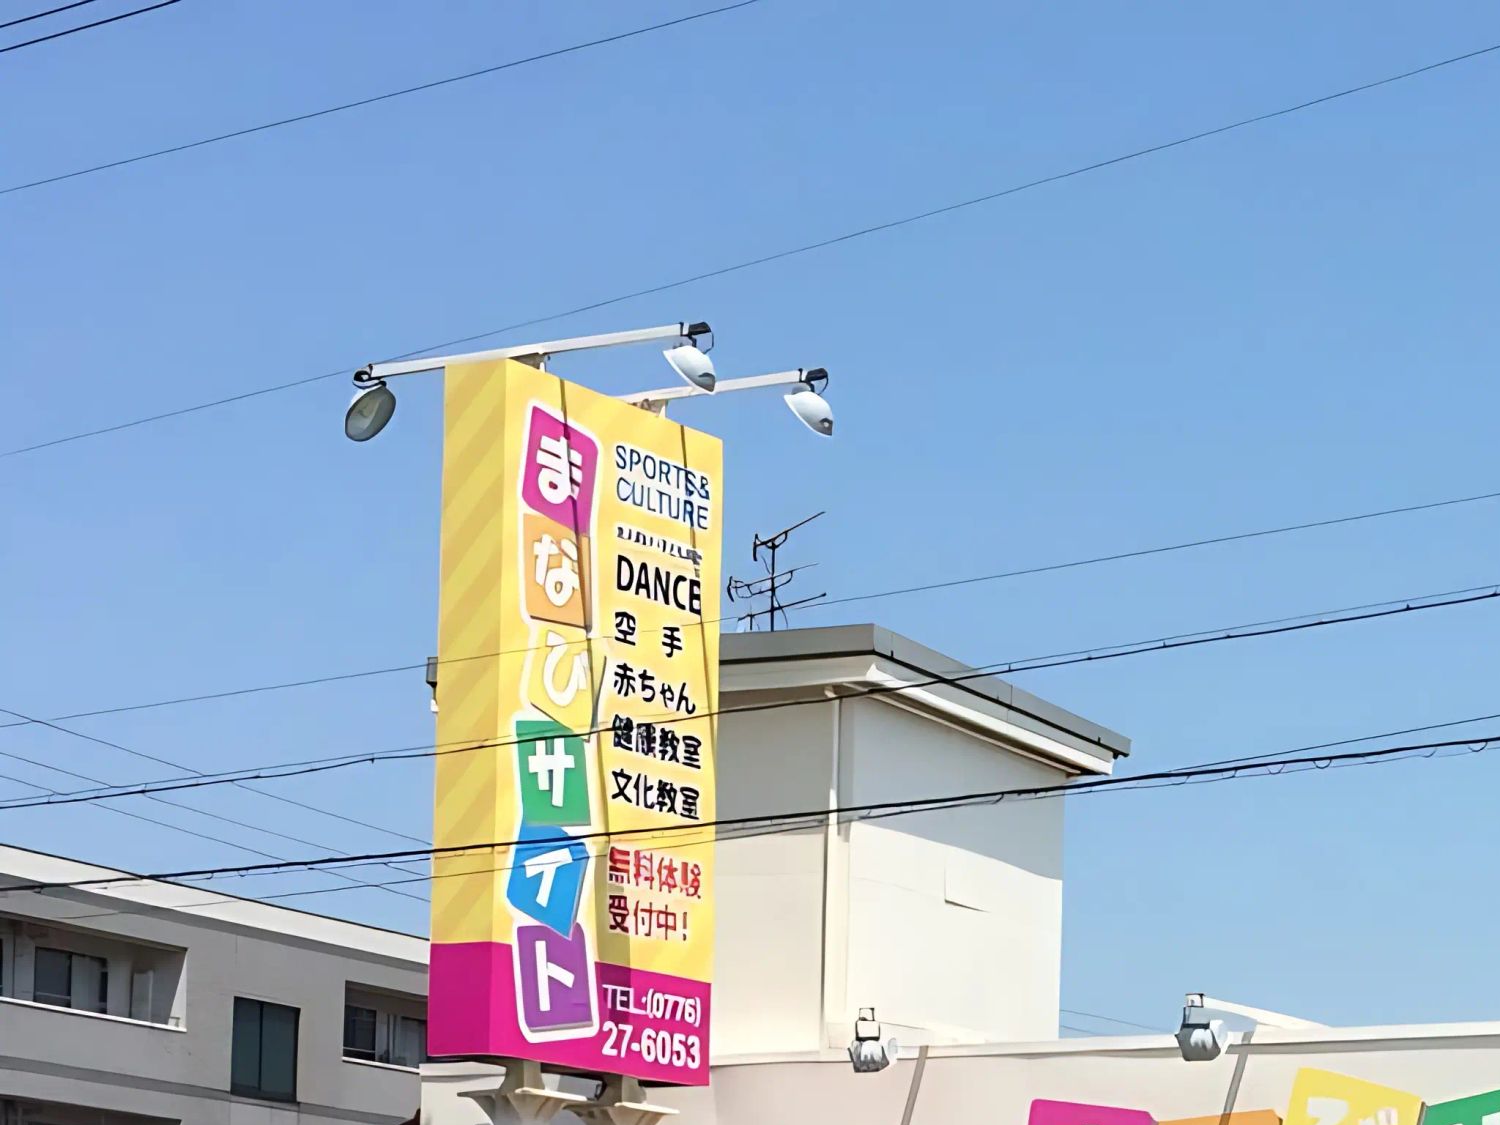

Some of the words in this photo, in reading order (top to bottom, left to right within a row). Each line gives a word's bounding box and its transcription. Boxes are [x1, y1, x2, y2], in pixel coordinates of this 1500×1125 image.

[616, 476, 708, 530] CULTURE
[616, 553, 702, 616] DANCE
[614, 663, 697, 715] 赤ちゃん
[525, 435, 590, 1012] まなびサイト
[612, 713, 702, 770] 健康教室
[611, 768, 700, 820] 文化教室
[608, 846, 702, 900] 無料体験
[602, 1020, 701, 1070] 27-6053
